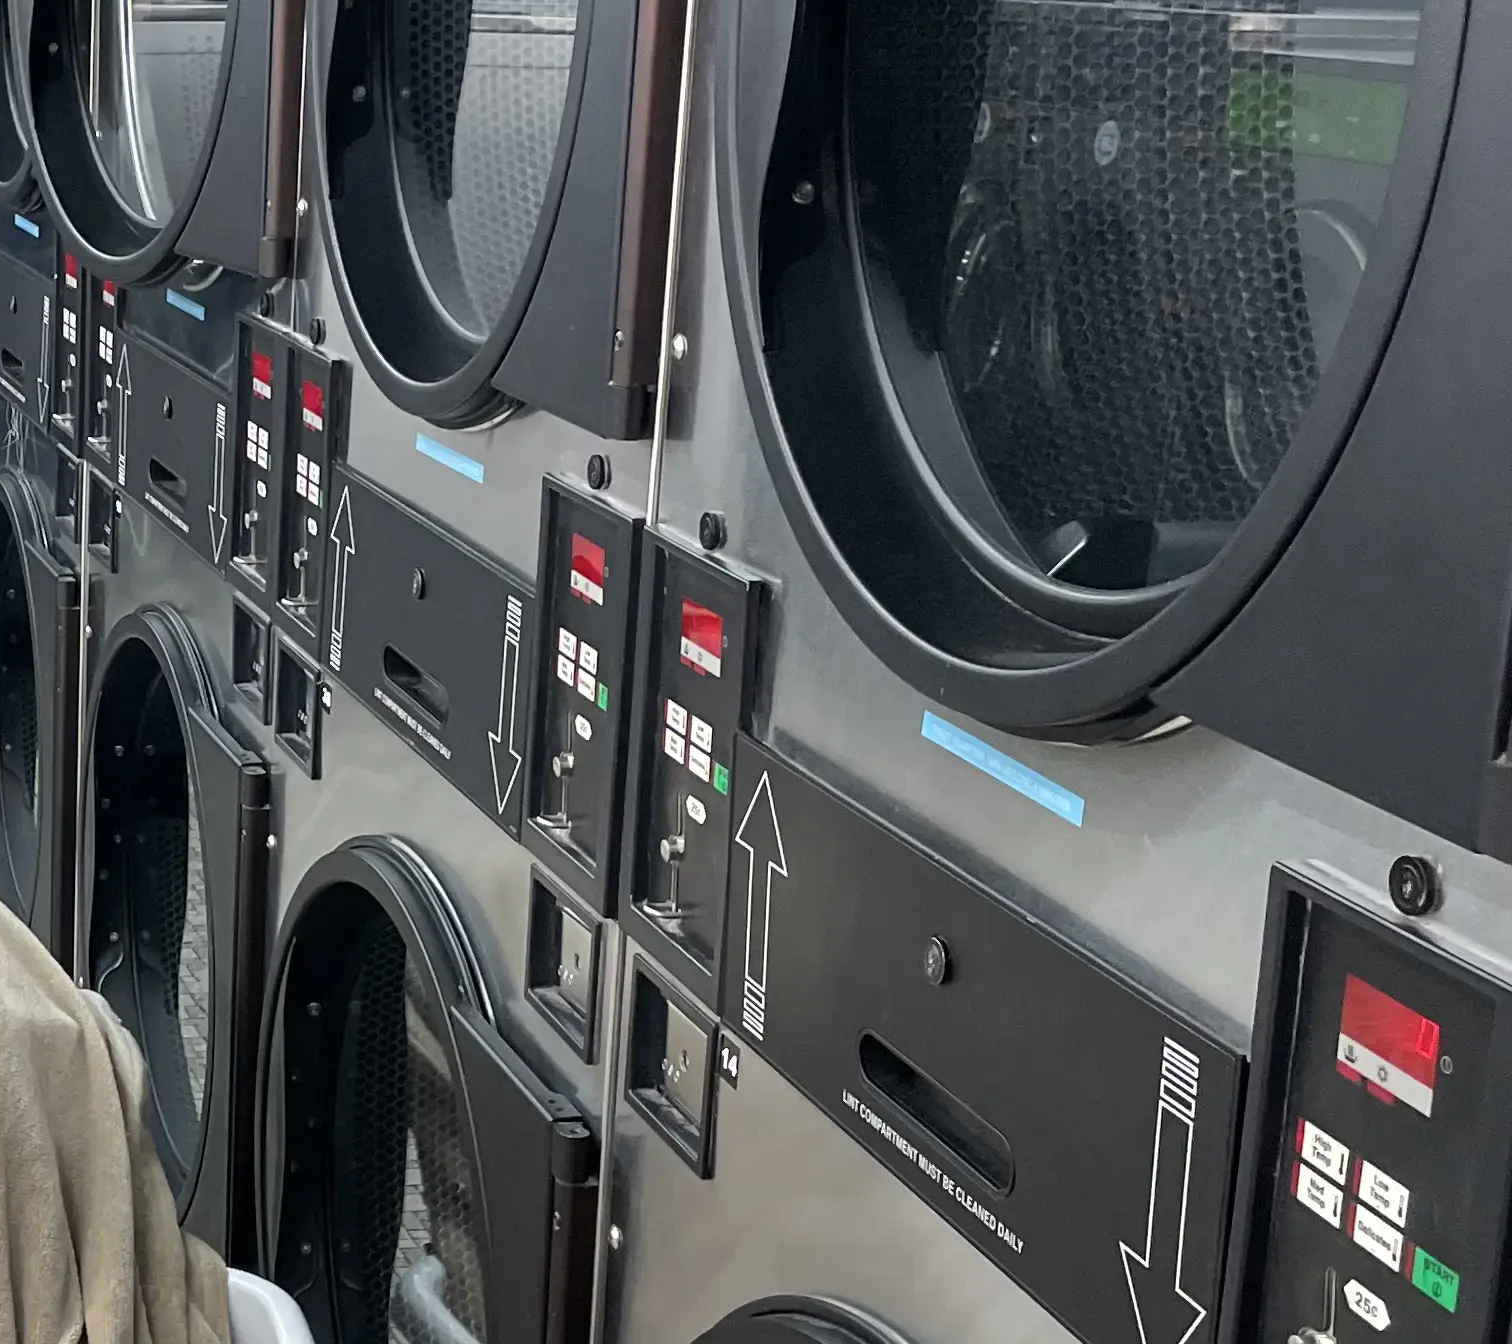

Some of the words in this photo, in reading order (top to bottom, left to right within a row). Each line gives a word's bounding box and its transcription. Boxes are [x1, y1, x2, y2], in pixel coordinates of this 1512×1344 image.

[721, 1047, 738, 1078] 14
[1314, 1133, 1333, 1154] High
[1312, 1146, 1332, 1168] Temp
[842, 1088, 860, 1113] LINT
[859, 1103, 919, 1163] COMPARTMENT
[918, 1153, 943, 1183] MUST
[942, 1173, 955, 1196] BE
[955, 1186, 997, 1231] CLEANED
[997, 1221, 1024, 1254] DAILY
[1373, 1174, 1389, 1193] Low
[1310, 1177, 1326, 1196] Med
[1370, 1187, 1391, 1209] Temp
[1358, 1219, 1392, 1252] Delicates
[1423, 1256, 1455, 1286] START
[1354, 1290, 1380, 1319] 25¢
